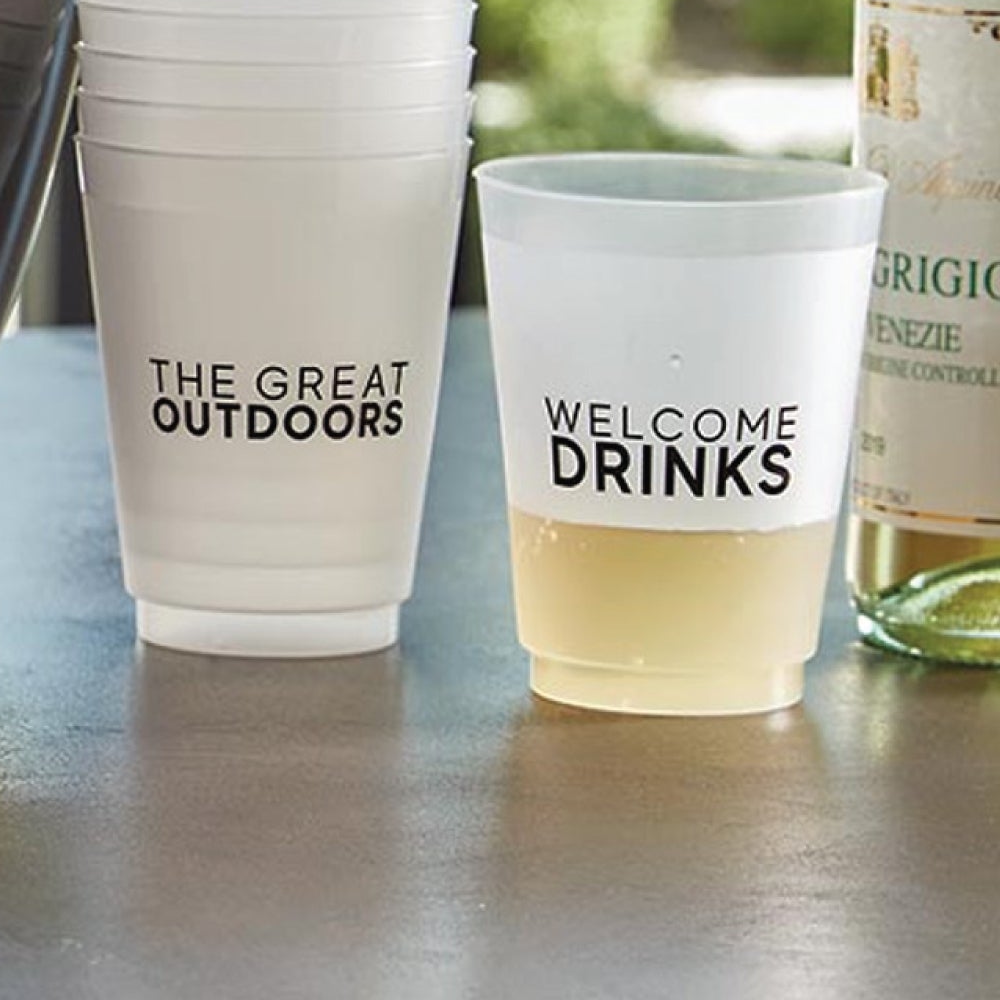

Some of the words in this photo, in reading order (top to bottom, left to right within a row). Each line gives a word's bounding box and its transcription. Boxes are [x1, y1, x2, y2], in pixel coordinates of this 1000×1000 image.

[149, 358, 235, 399] THE
[256, 361, 409, 401] GREAT
[153, 397, 403, 440] OUTDOORS
[545, 396, 798, 442] WELCOME
[551, 435, 792, 497] DRINKS
